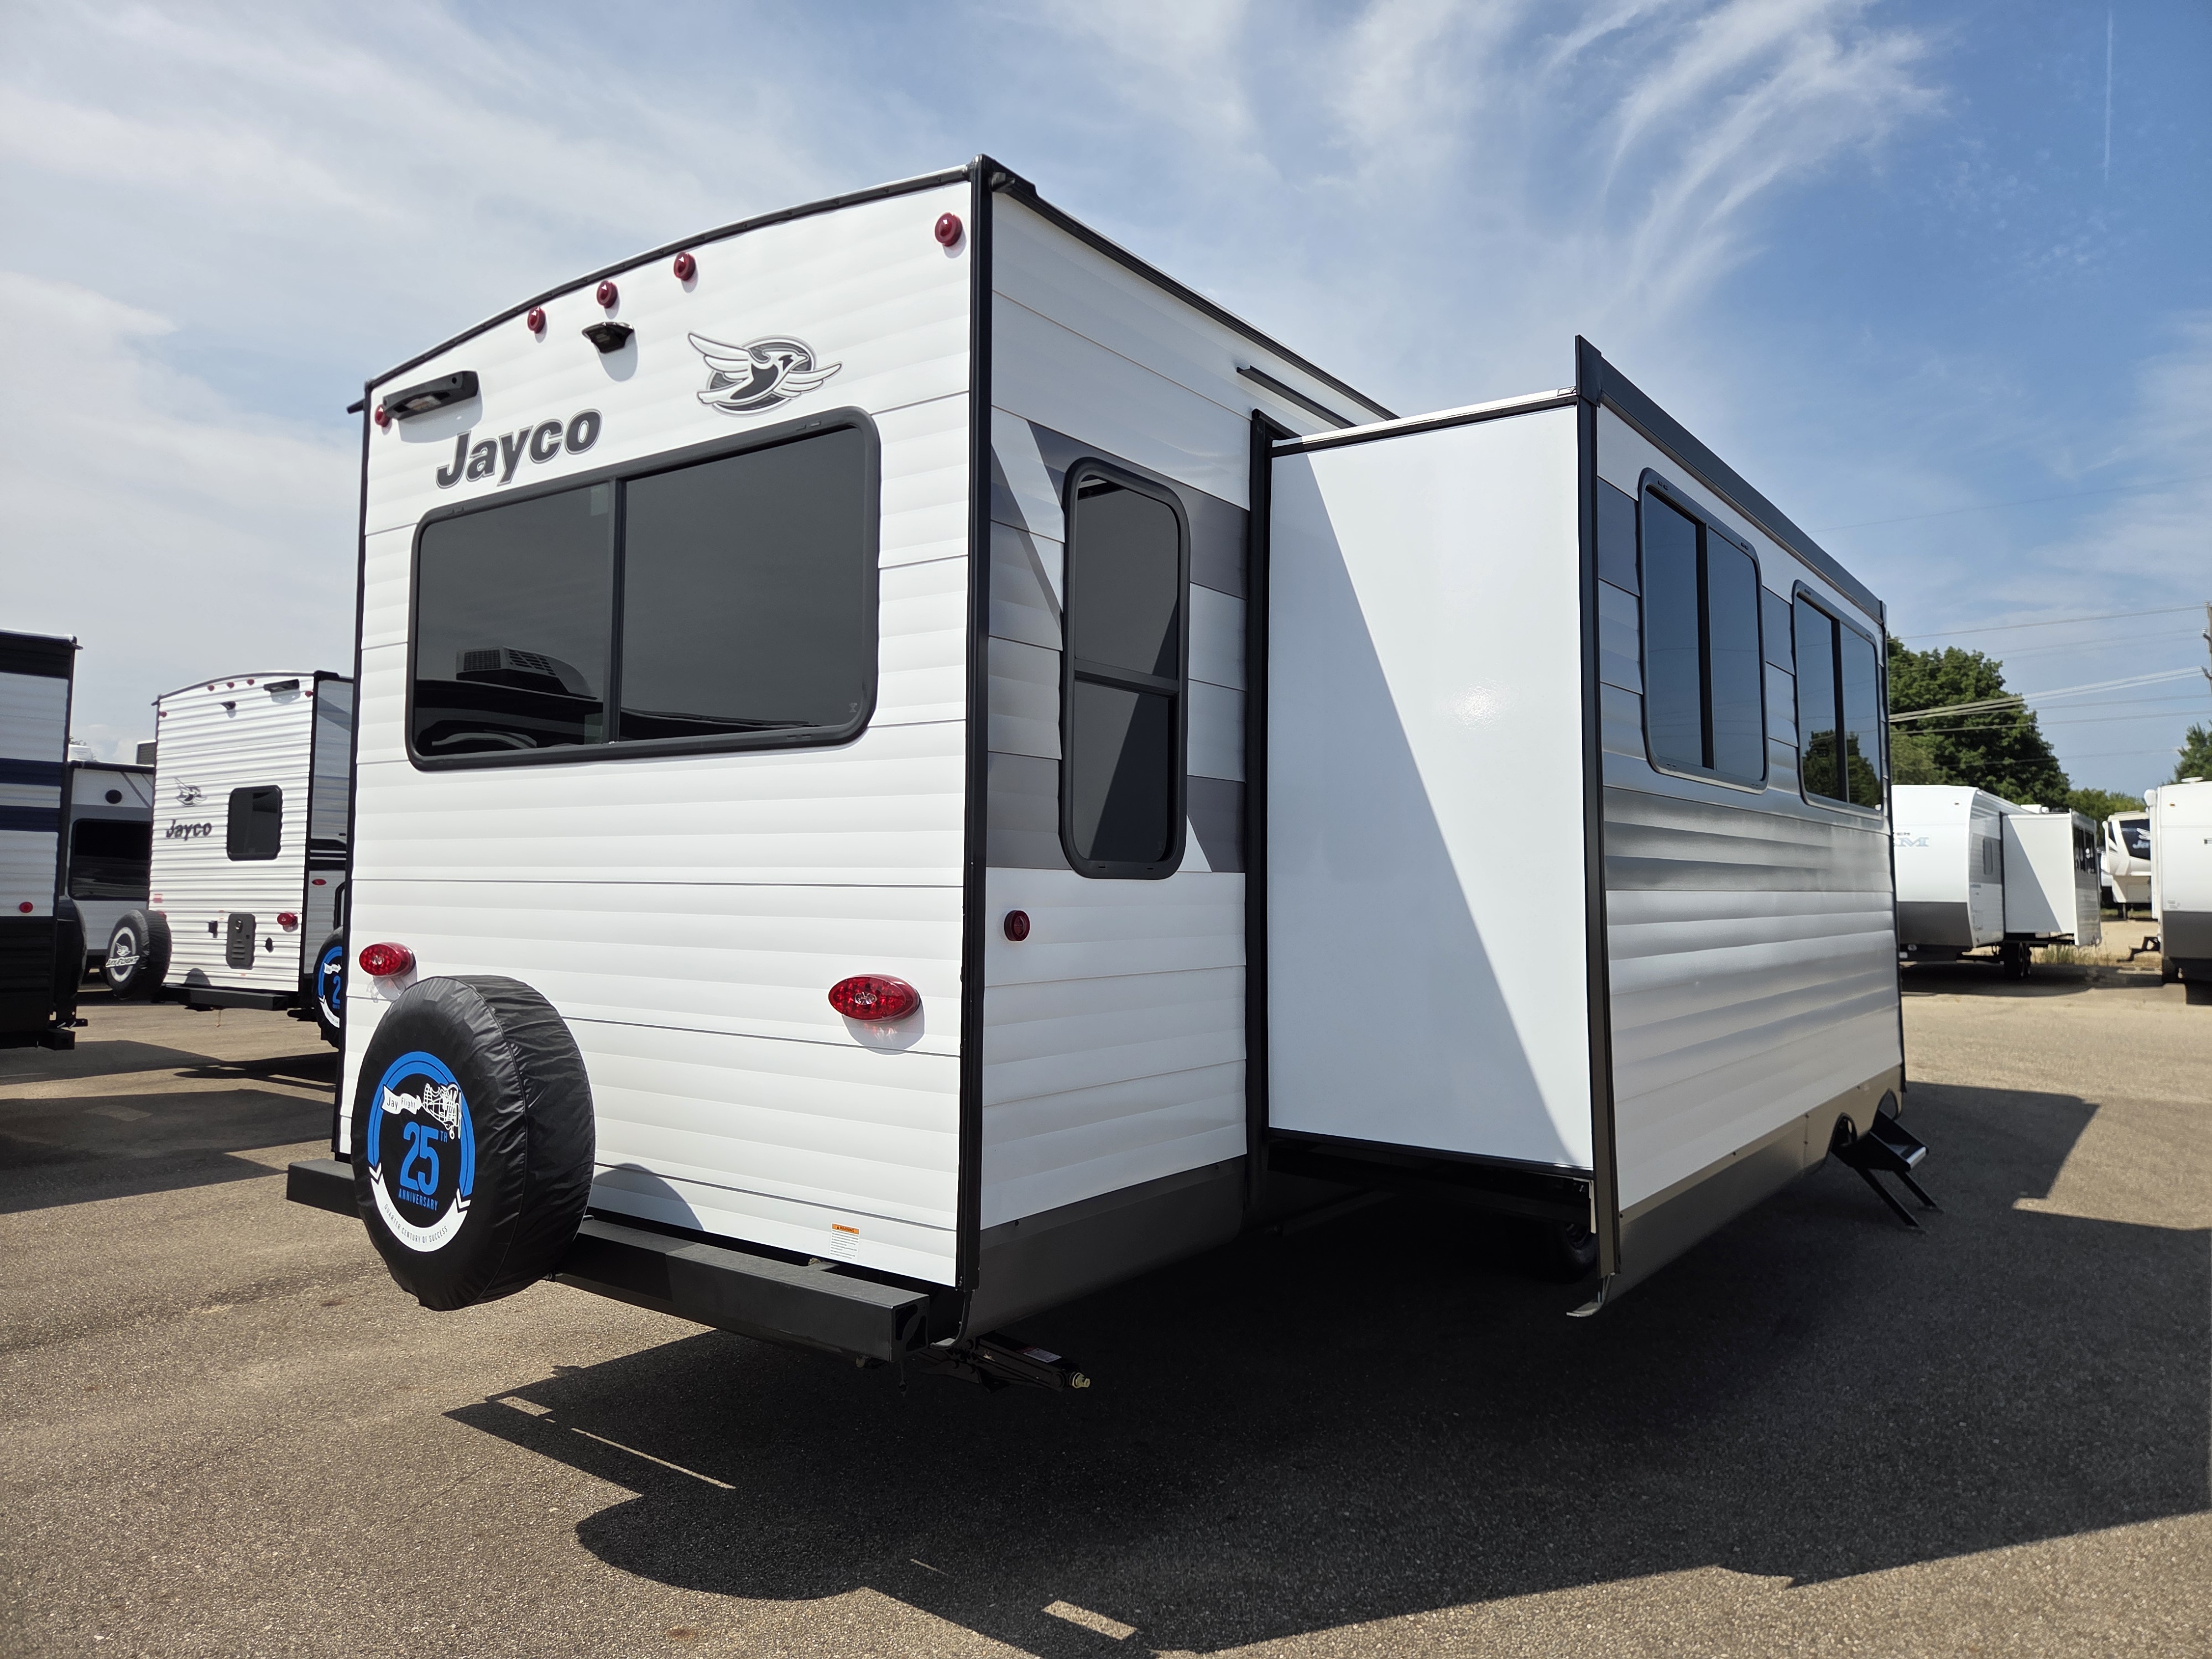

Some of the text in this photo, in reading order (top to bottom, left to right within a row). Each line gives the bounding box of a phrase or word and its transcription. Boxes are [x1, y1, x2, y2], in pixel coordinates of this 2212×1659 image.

[436, 409, 603, 489] Jayco
[166, 819, 212, 841] Jayco
[387, 1097, 415, 1110] Jay Flight
[398, 1188, 438, 1211] ANNIVERSARY
[384, 1203, 401, 1230] QUARTER
[401, 1227, 420, 1243] CENTURY
[429, 1225, 448, 1242] SUCCESS
